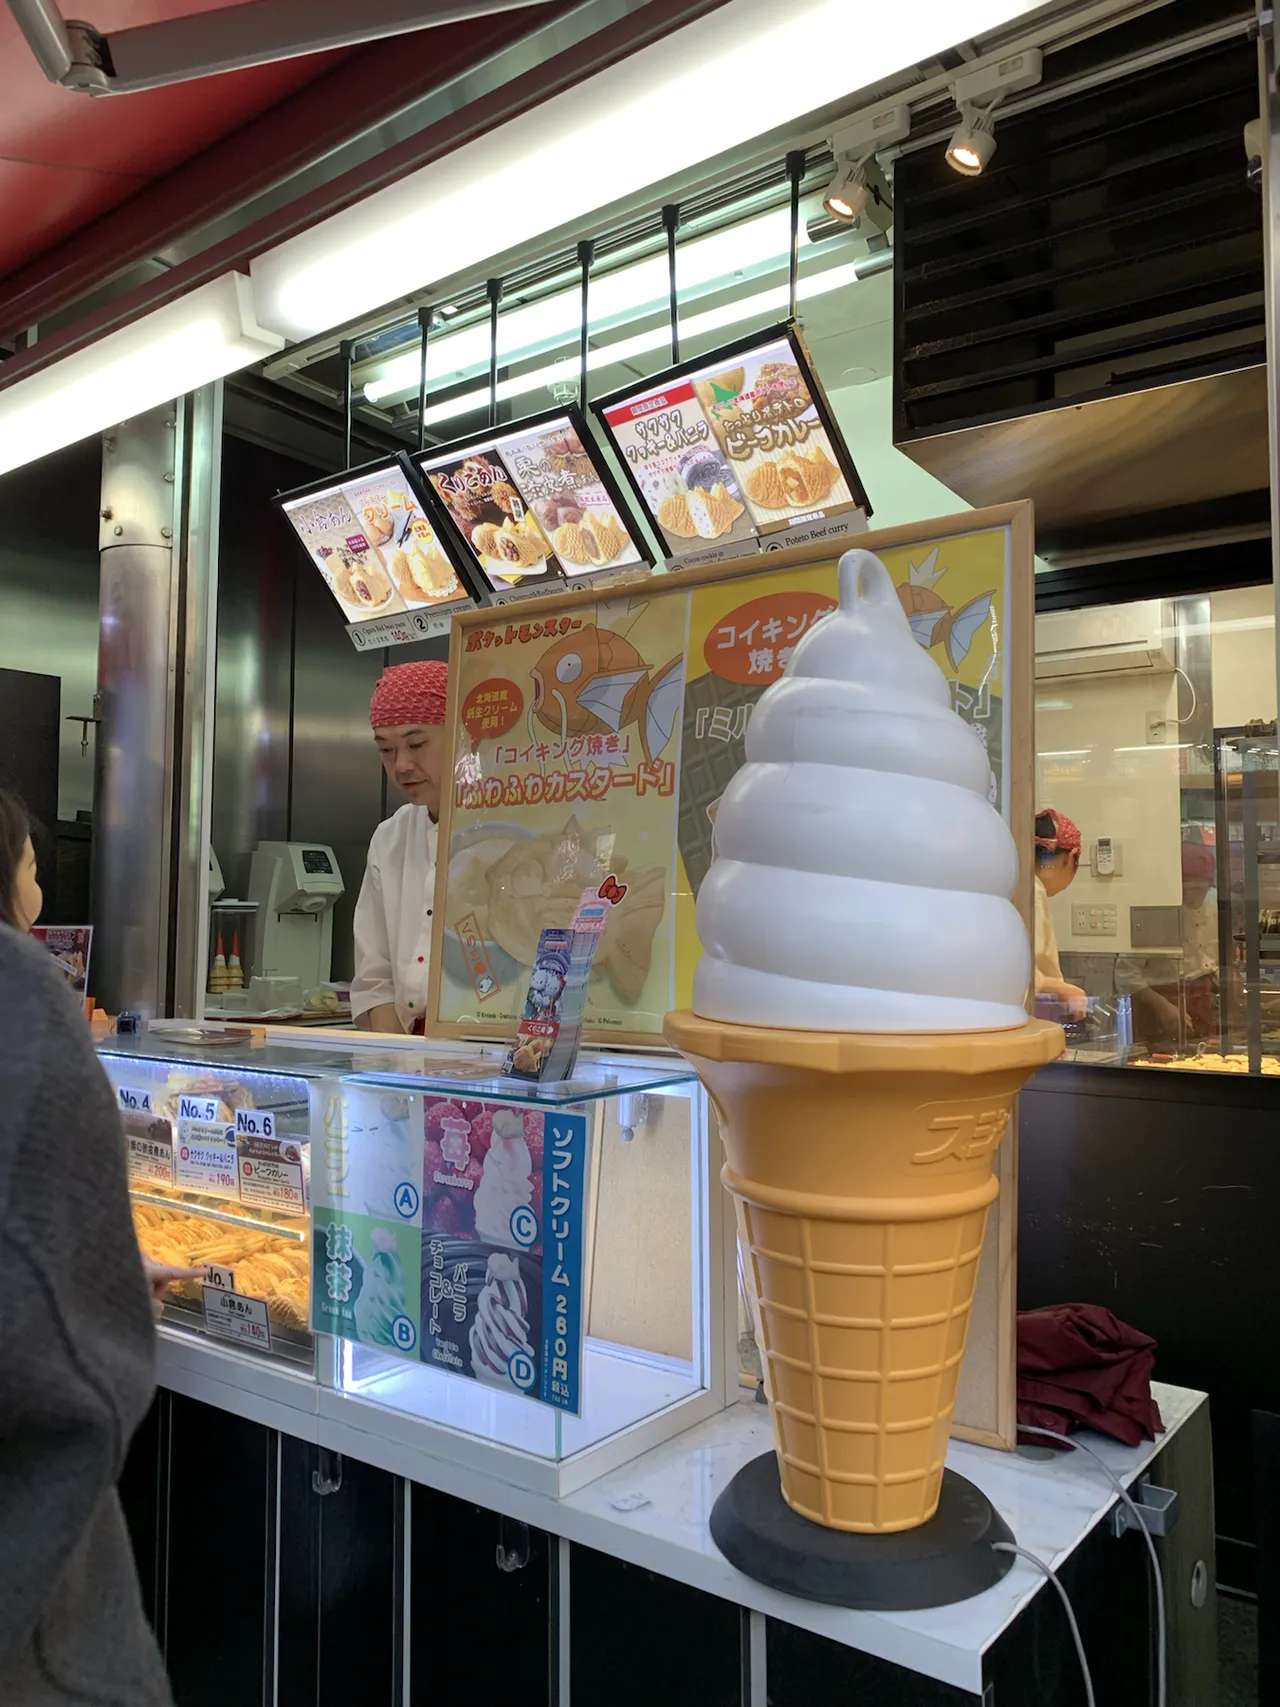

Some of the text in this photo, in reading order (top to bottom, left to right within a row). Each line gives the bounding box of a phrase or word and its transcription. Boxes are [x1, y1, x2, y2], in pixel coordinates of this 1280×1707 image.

[635, 409, 682, 439] サクサク
[626, 420, 709, 463] クッキー&バニラ
[725, 418, 822, 460] ビーフカレー
[438, 465, 507, 494] くりごあん
[515, 455, 552, 479] 栗の
[299, 507, 352, 534] 小倉あん
[363, 495, 417, 523] クリーム
[785, 523, 849, 546] Poteto Beef curry
[465, 618, 583, 652] ポケットモンスター
[476, 689, 508, 704] 北海道産
[495, 735, 630, 764] 「コイキング焼き」
[550, 1126, 574, 1287] ソフトクリーム
[325, 1222, 353, 1302] 抹茶
[428, 1239, 443, 1336] チョコレート
[442, 1280, 454, 1299] &
[452, 1262, 468, 1323] バニラ
